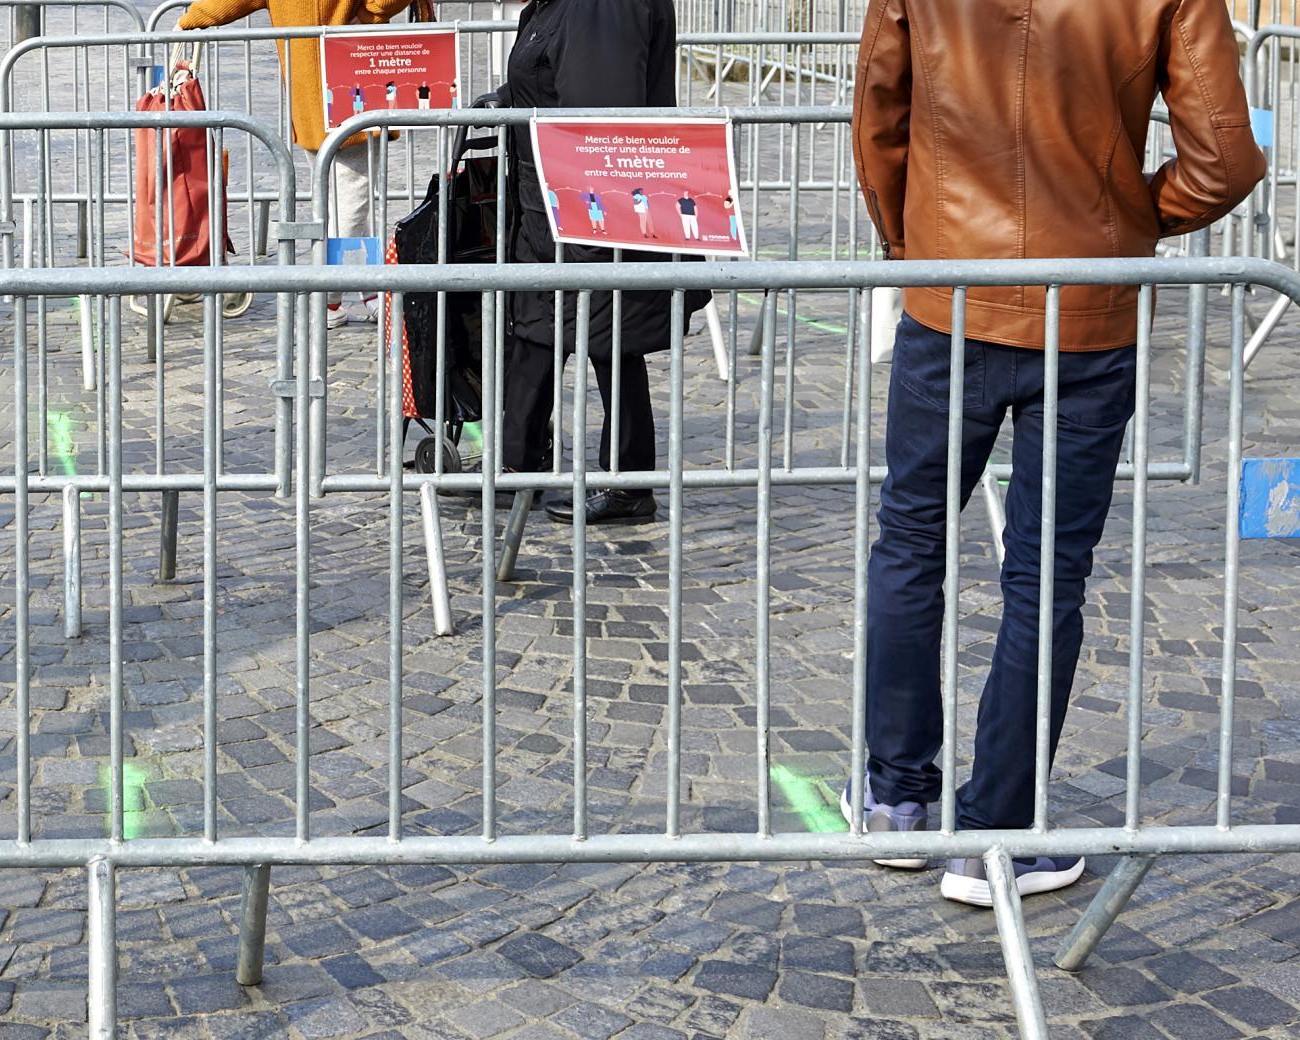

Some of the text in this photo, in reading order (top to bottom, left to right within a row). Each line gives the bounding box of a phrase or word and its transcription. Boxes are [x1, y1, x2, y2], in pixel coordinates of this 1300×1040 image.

[369, 57, 411, 67] 1 mètre
[585, 136, 680, 144] Merci de bien vouloir
[575, 146, 617, 154] respecter
[639, 146, 676, 154] distance
[678, 146, 691, 154] de
[604, 155, 665, 168] 1 mètre
[610, 170, 643, 178] chaque
[645, 171, 688, 179] personne
